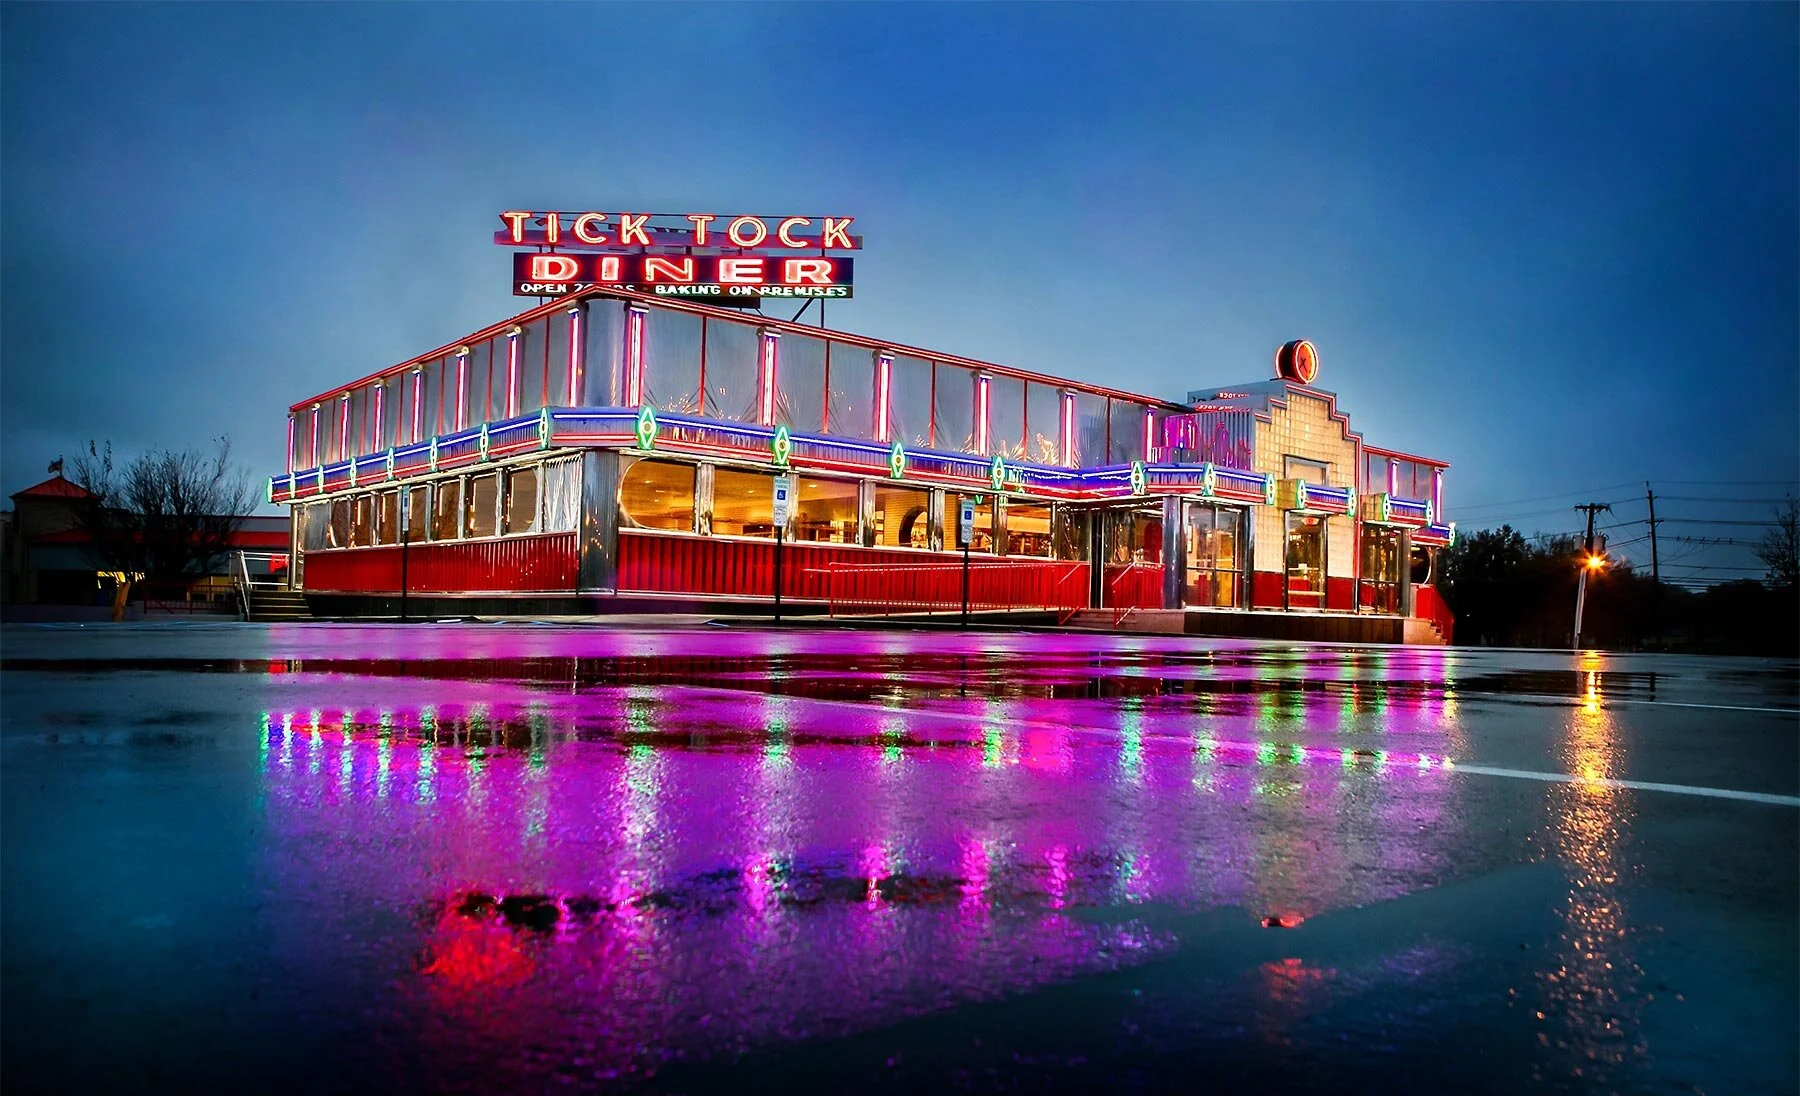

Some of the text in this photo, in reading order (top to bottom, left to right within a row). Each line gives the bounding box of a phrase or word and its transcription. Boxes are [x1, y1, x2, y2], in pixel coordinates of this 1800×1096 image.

[503, 212, 853, 249] TICK TOCK
[531, 256, 834, 283] DINER
[520, 283, 567, 293] OPEN
[655, 285, 721, 295] BAKING
[729, 286, 753, 296] ON
[760, 286, 848, 297] PREMISES
